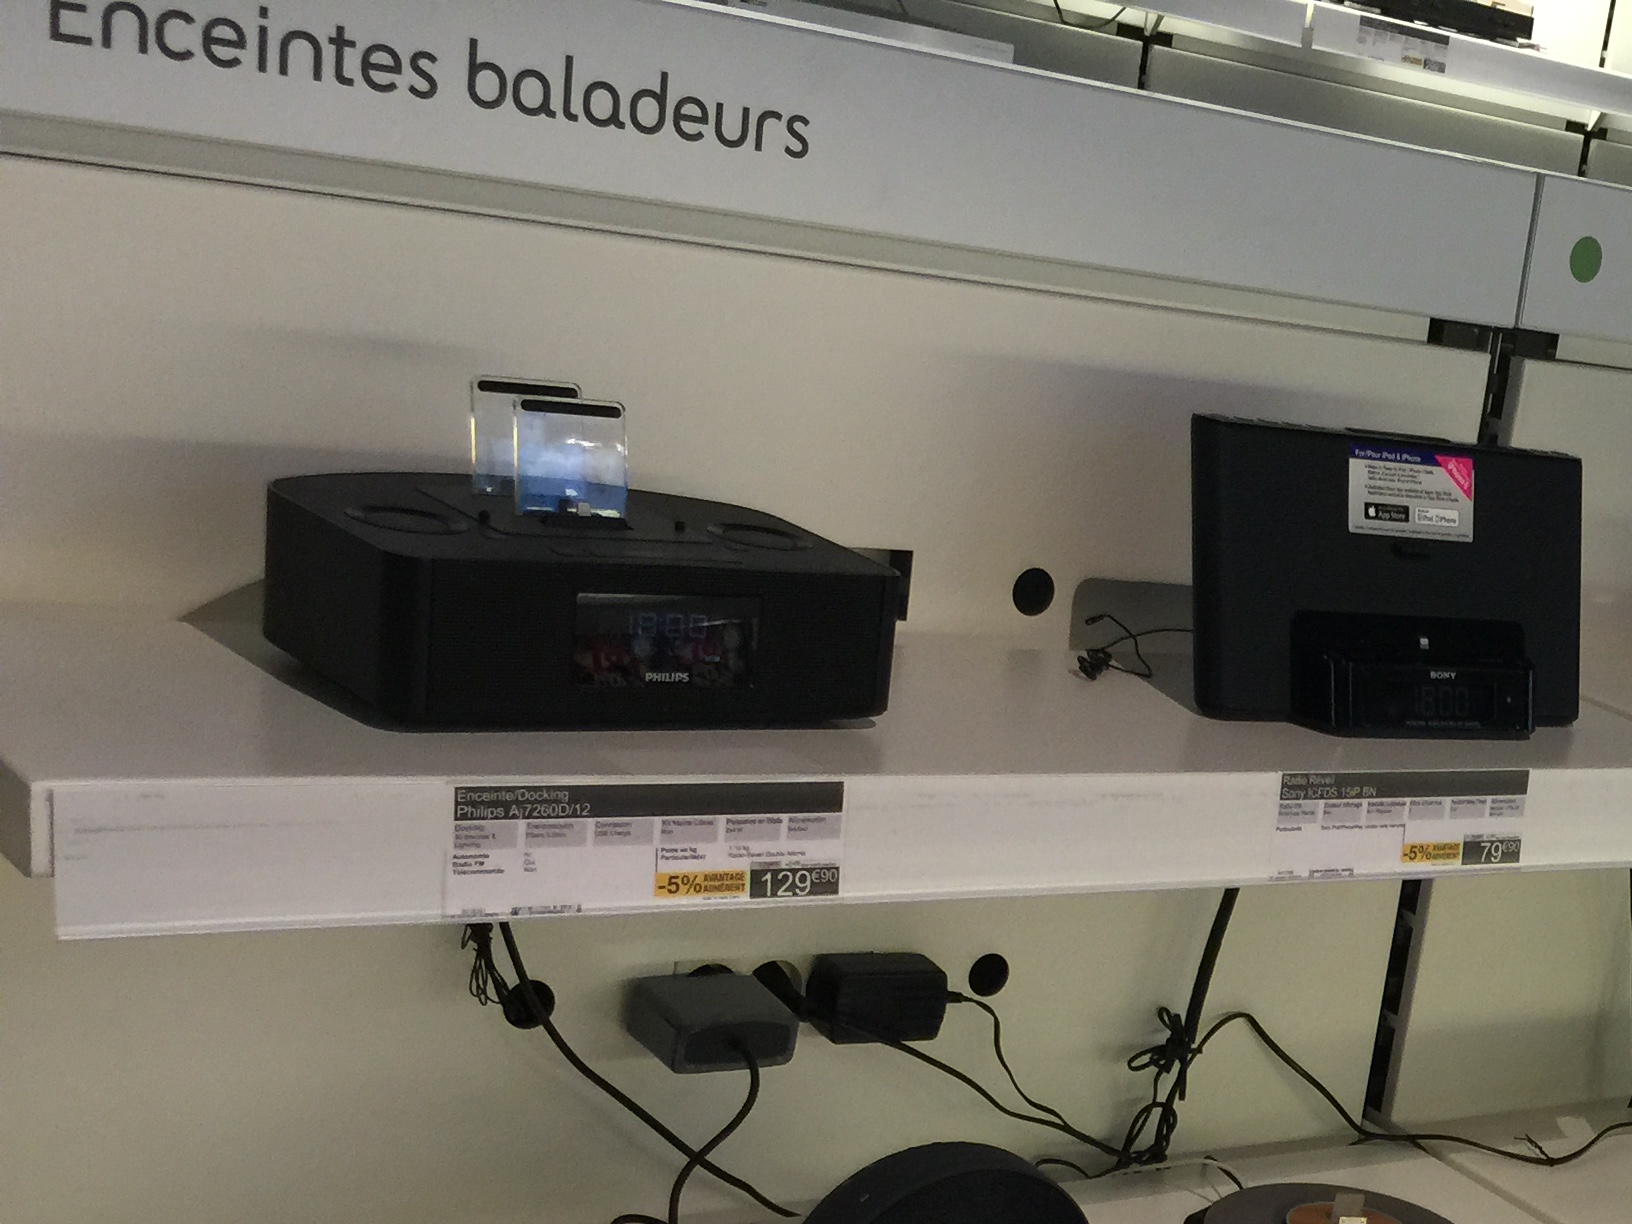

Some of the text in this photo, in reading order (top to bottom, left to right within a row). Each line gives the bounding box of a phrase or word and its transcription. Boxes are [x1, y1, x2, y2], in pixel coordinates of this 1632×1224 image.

[49, 0, 812, 159] Enceintes baladeurs
[645, 672, 689, 682] PHILIPS
[1430, 671, 1456, 679] SONY
[457, 789, 568, 802] Enceinte/Docking
[1282, 788, 1305, 799] Sony
[1363, 786, 1376, 796] BN
[457, 806, 504, 819] Philips
[1403, 846, 1431, 860] -5%
[704, 872, 745, 882] AVANTAGE
[657, 875, 701, 894] -5%
